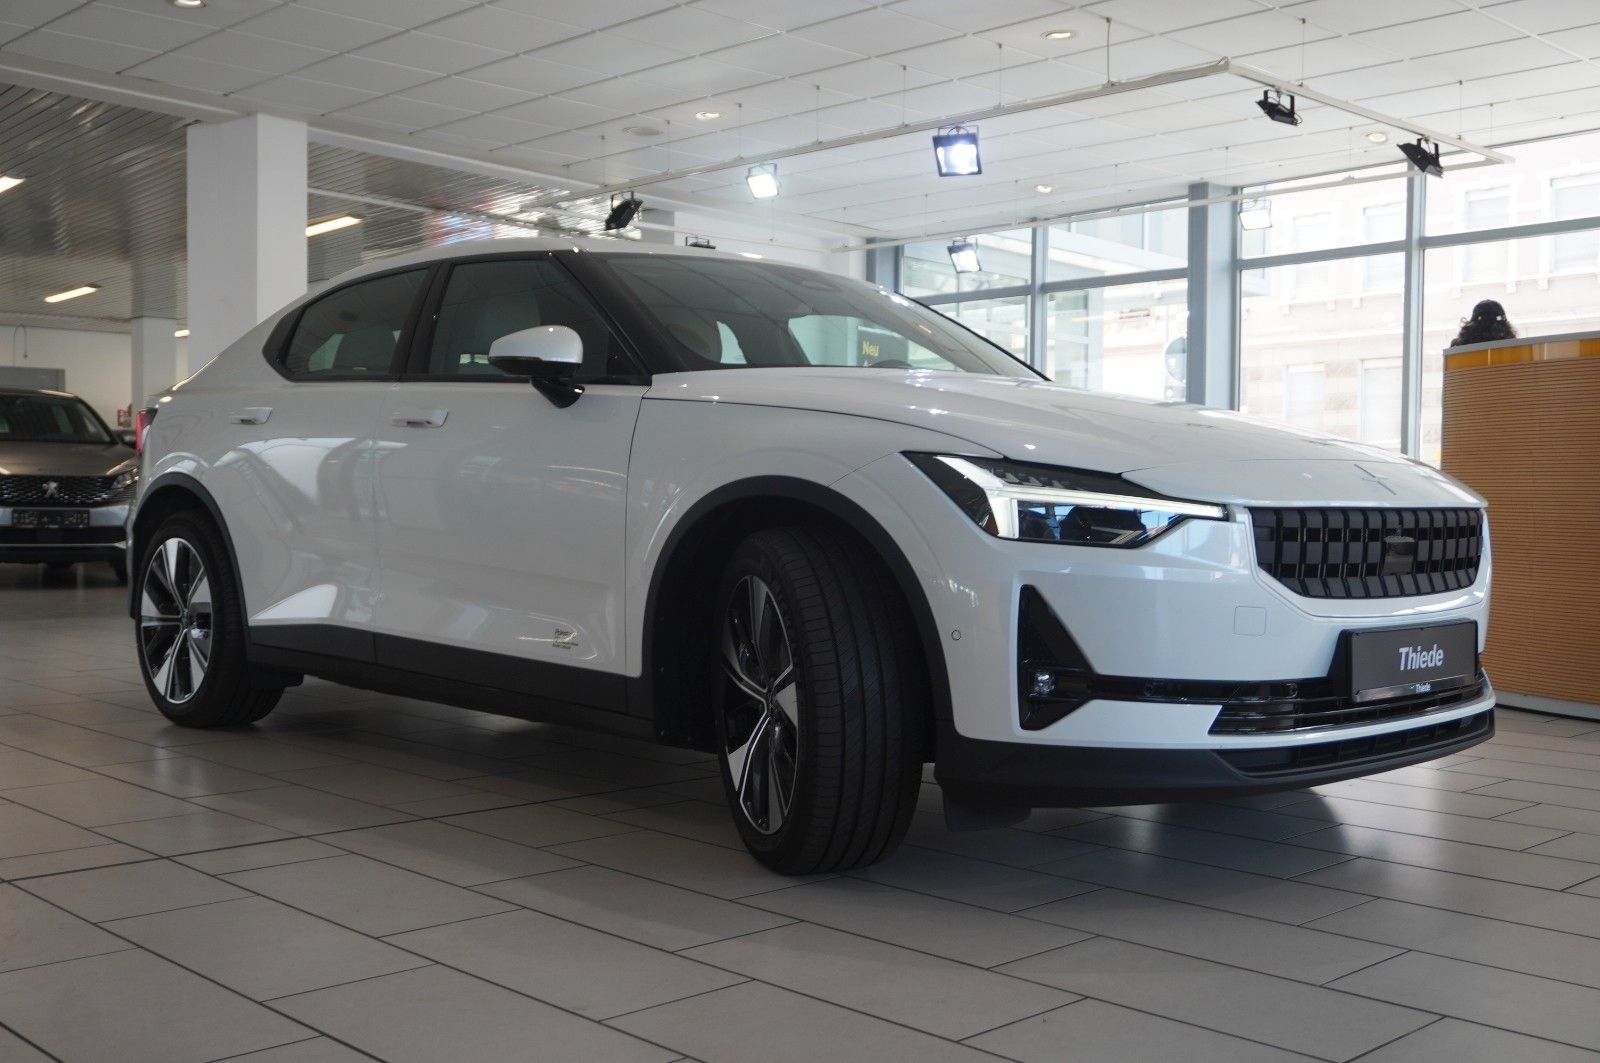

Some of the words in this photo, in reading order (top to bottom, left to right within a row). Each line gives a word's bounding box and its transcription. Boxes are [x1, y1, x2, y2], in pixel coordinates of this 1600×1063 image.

[862, 341, 880, 357] Neu
[1399, 644, 1444, 671] Thiede
[1415, 683, 1431, 693] Thiede
